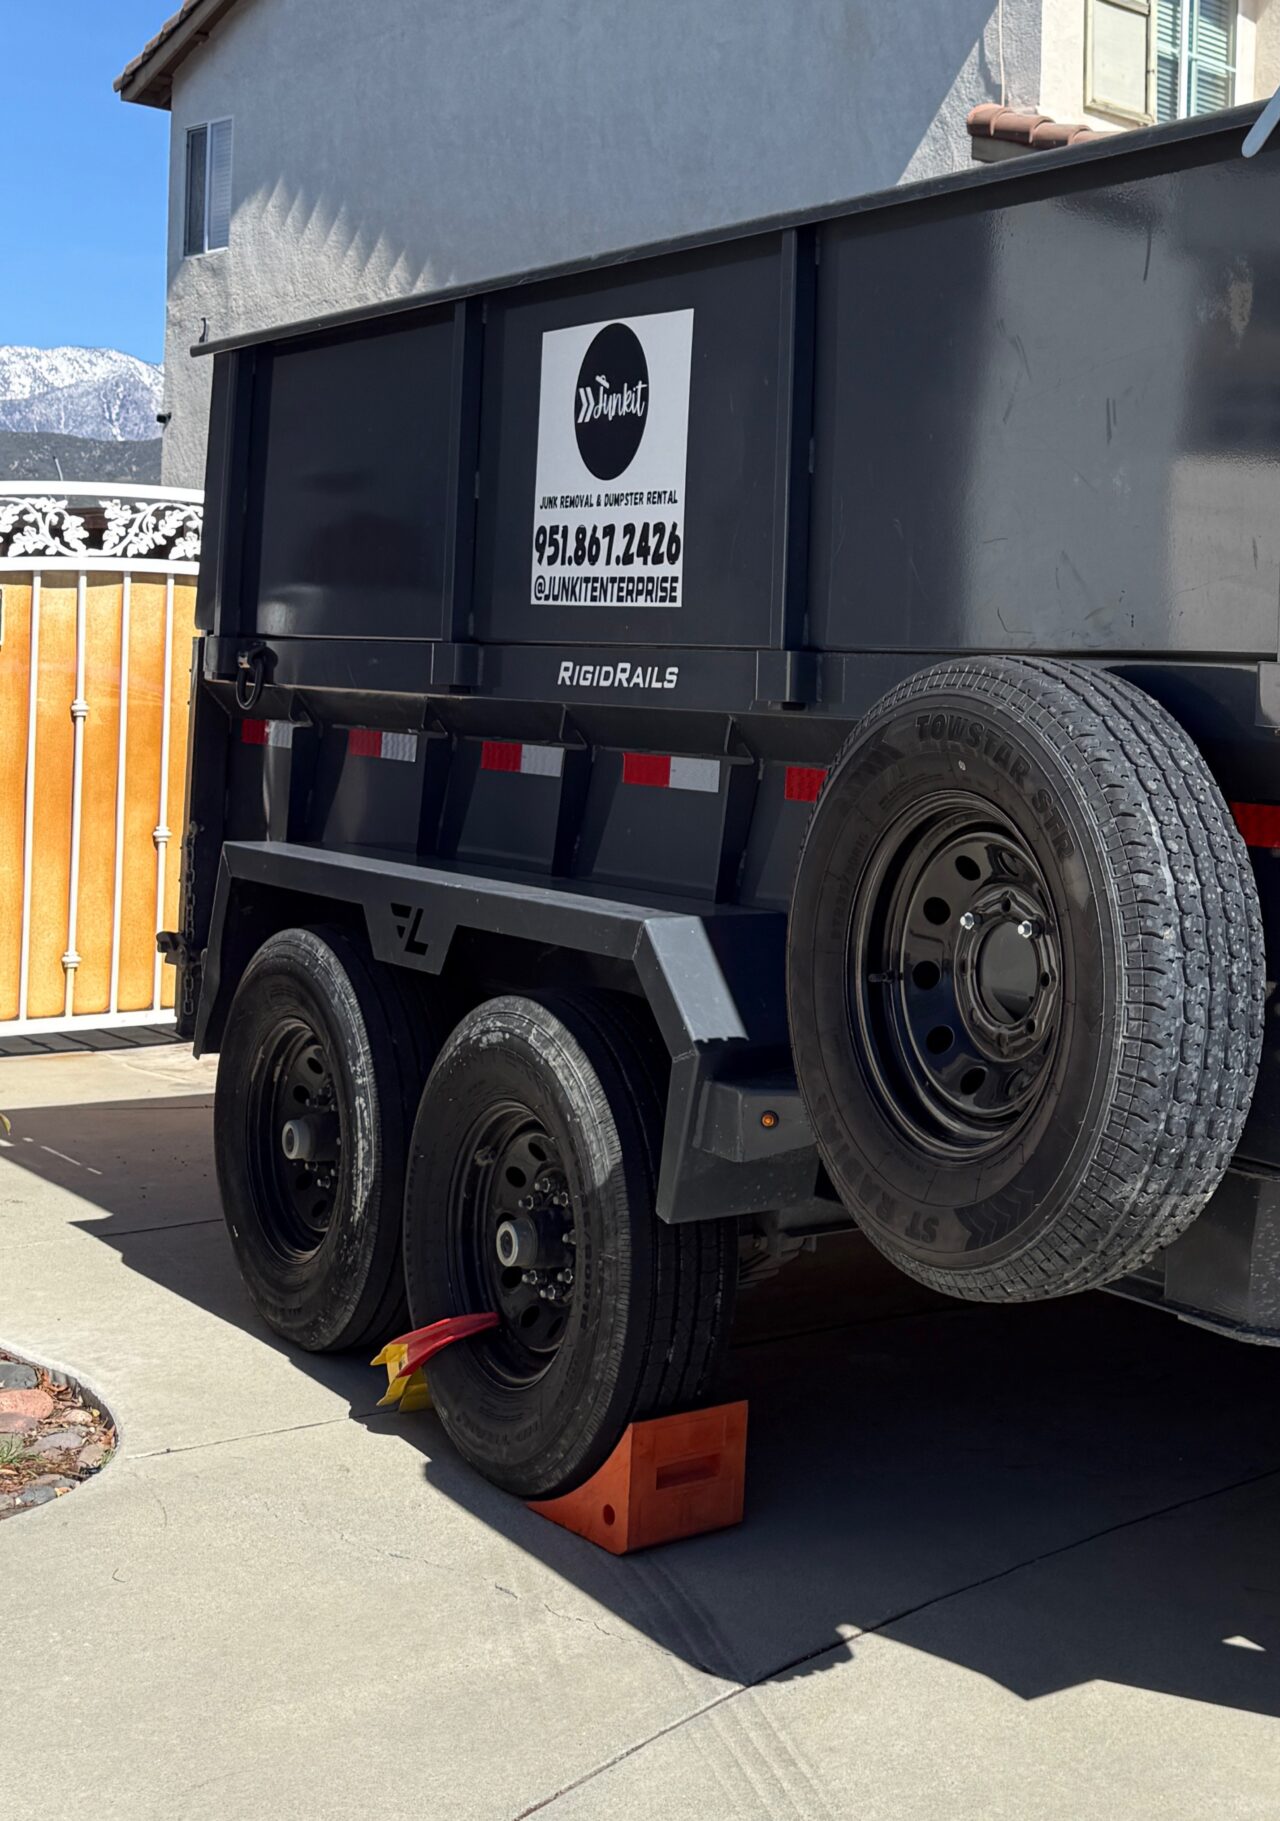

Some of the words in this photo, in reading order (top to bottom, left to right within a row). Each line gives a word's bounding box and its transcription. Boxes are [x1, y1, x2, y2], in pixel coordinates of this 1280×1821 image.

[593, 380, 648, 421] Junkit
[540, 496, 558, 510] JUNK
[560, 494, 594, 509] REMOVAL
[596, 494, 602, 507] &
[604, 491, 644, 507] DUMPSTER
[646, 489, 678, 505] RENTAL
[535, 521, 681, 566] 951.867.2426
[534, 575, 679, 603] @JUNKITENTERPRISE
[915, 713, 1031, 787] TOWSTAR
[1031, 788, 1074, 857] STR
